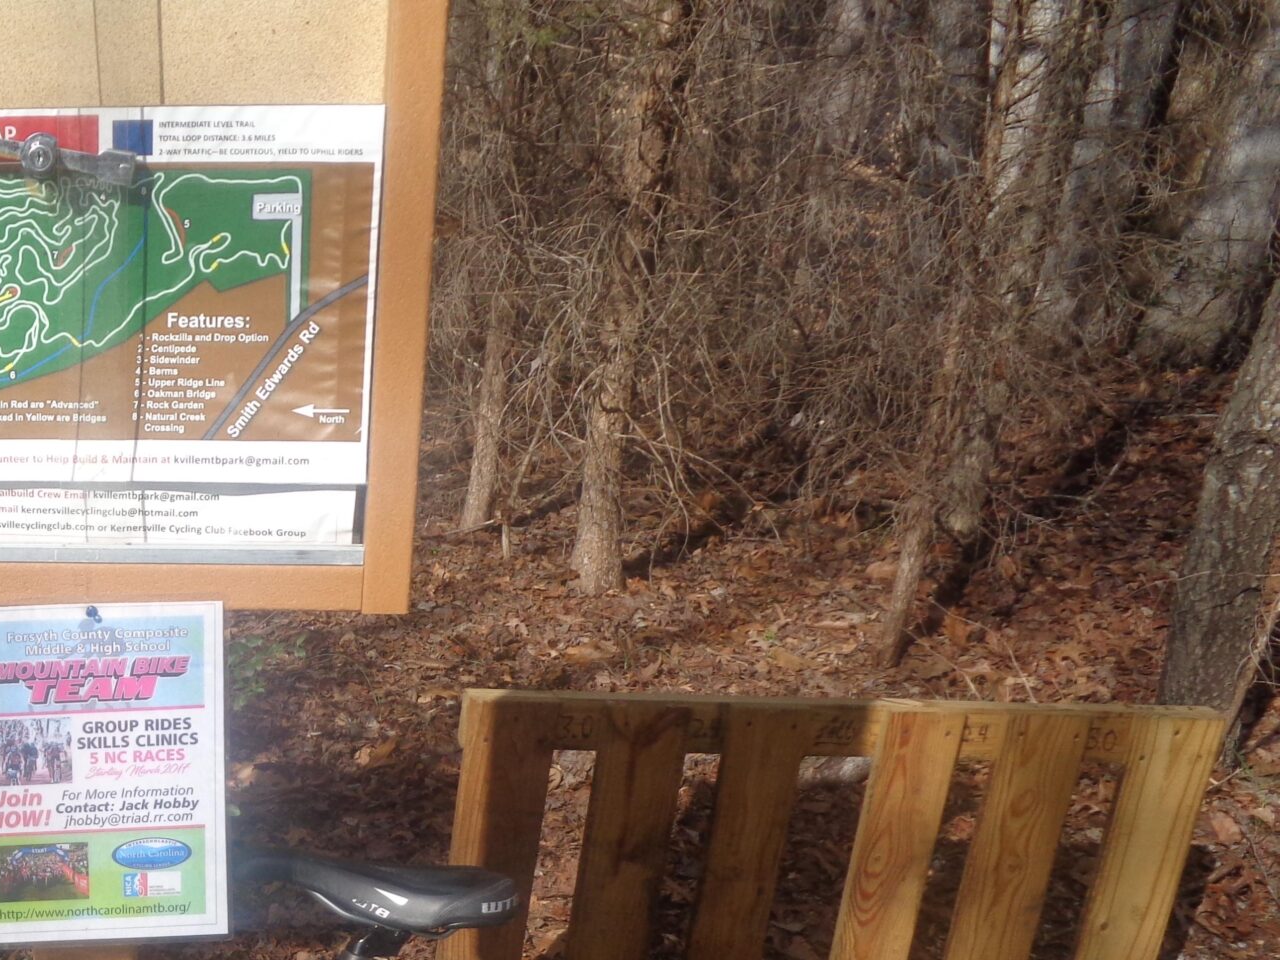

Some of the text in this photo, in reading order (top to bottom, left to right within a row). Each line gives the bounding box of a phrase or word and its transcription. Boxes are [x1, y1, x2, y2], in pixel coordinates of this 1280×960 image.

[256, 203, 301, 216] Parking
[167, 312, 250, 328] Features:
[152, 333, 269, 344] Rockzilla and Drop Option
[151, 344, 196, 354] Centipede
[150, 356, 200, 365] Sidewinder
[149, 367, 178, 376] Berms
[148, 379, 225, 389] Upper Ridge Line
[227, 321, 320, 438] Smith Edwards Rd
[147, 390, 216, 400] Oakman Bridge
[10, 401, 29, 409] Red
[146, 401, 204, 410] Rock Garden
[25, 414, 55, 422] Yellow
[73, 414, 106, 423] Bridges
[145, 412, 205, 422] Natural Creek
[319, 415, 344, 424] North
[144, 423, 184, 433] Crossing
[46, 455, 69, 465] Help
[73, 455, 98, 464] Build
[112, 455, 158, 464] Maintain
[174, 455, 310, 467] kvillemtbpark@gmail.com
[38, 489, 61, 499] Crew
[64, 490, 90, 500] Email
[93, 490, 220, 503] kvillemtbpark@gmail.com
[21, 506, 198, 518] kernersvillecyclingclub@hotmail.com
[110, 523, 166, 533] Kernersville
[168, 524, 202, 535] Cycling
[205, 525, 226, 534] Club
[228, 526, 273, 537] Facebook
[276, 528, 307, 539] Group
[7, 627, 188, 644] Forsyth County Composite
[25, 640, 171, 656] Middle & High School
[131, 655, 191, 677] BIKE
[26, 676, 158, 704] TEAM
[82, 717, 192, 734] GROUP RIDES
[77, 732, 199, 750] SKILLS CLINICS
[90, 748, 185, 764] 5 NC RACES
[61, 784, 194, 801] For More Information
[56, 797, 199, 815] Contact: Jack Hobby
[64, 812, 194, 829] jhobby@triad.rr.com
[0, 901, 191, 921] http://www.northcarolinamtb.org/
